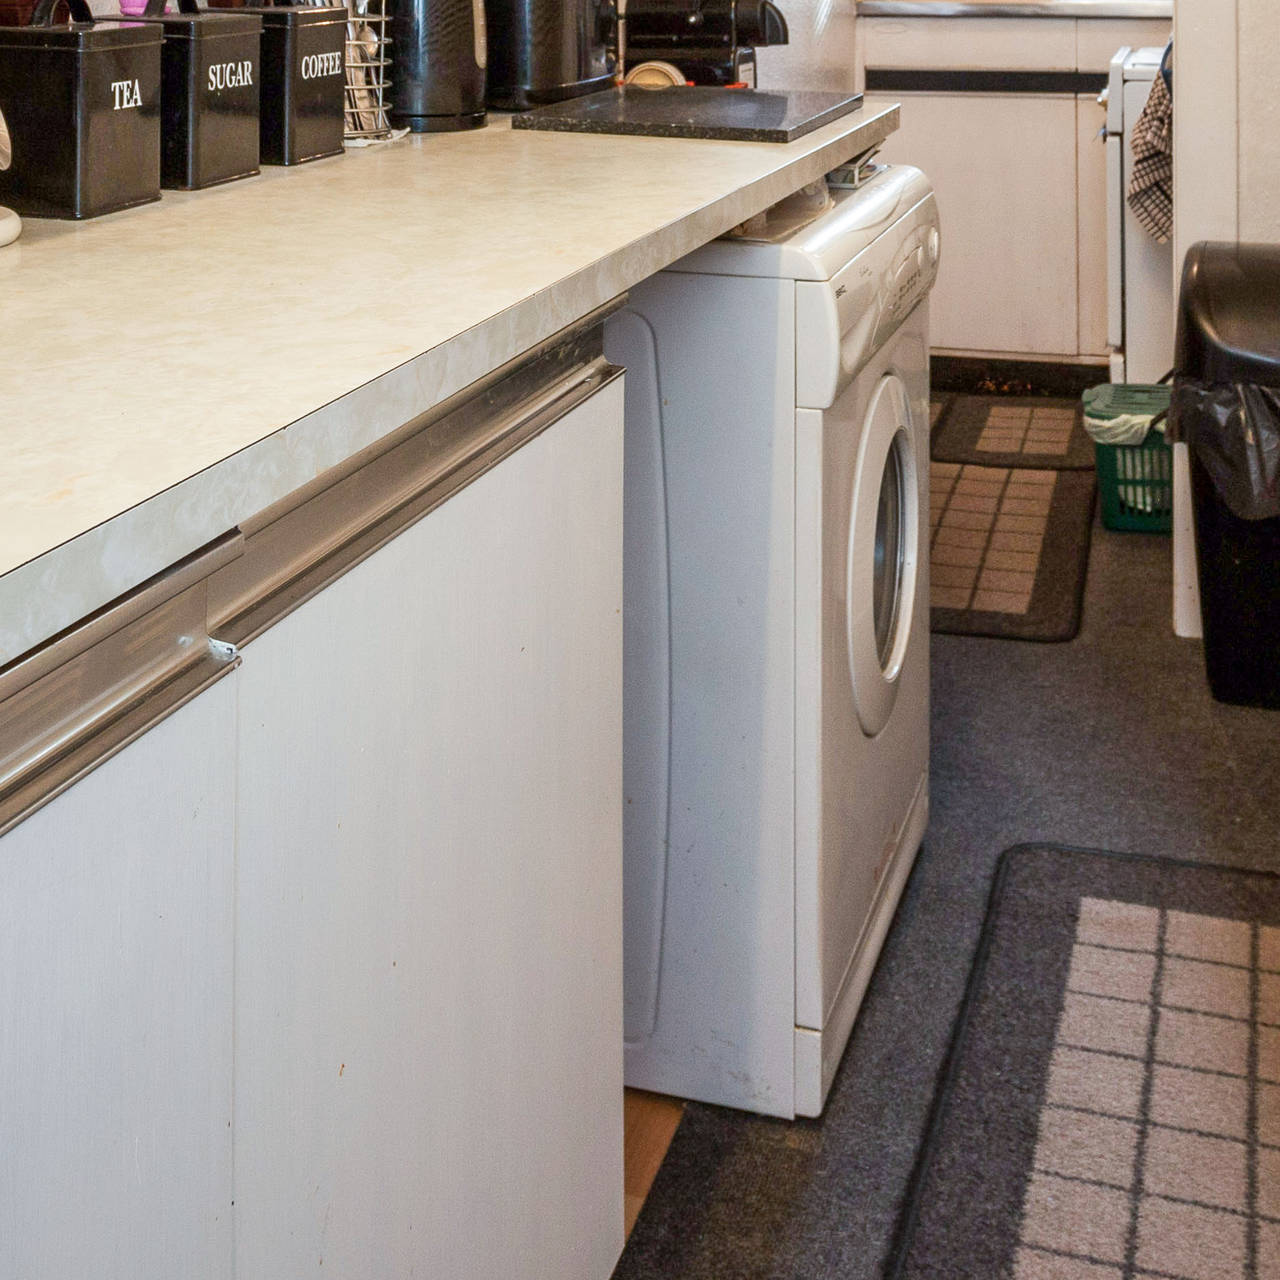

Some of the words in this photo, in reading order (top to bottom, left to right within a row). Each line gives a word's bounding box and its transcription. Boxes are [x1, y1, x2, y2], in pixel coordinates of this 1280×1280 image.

[208, 61, 253, 91] SUGAR
[301, 52, 341, 80] COFFEE
[111, 79, 142, 110] TEA
